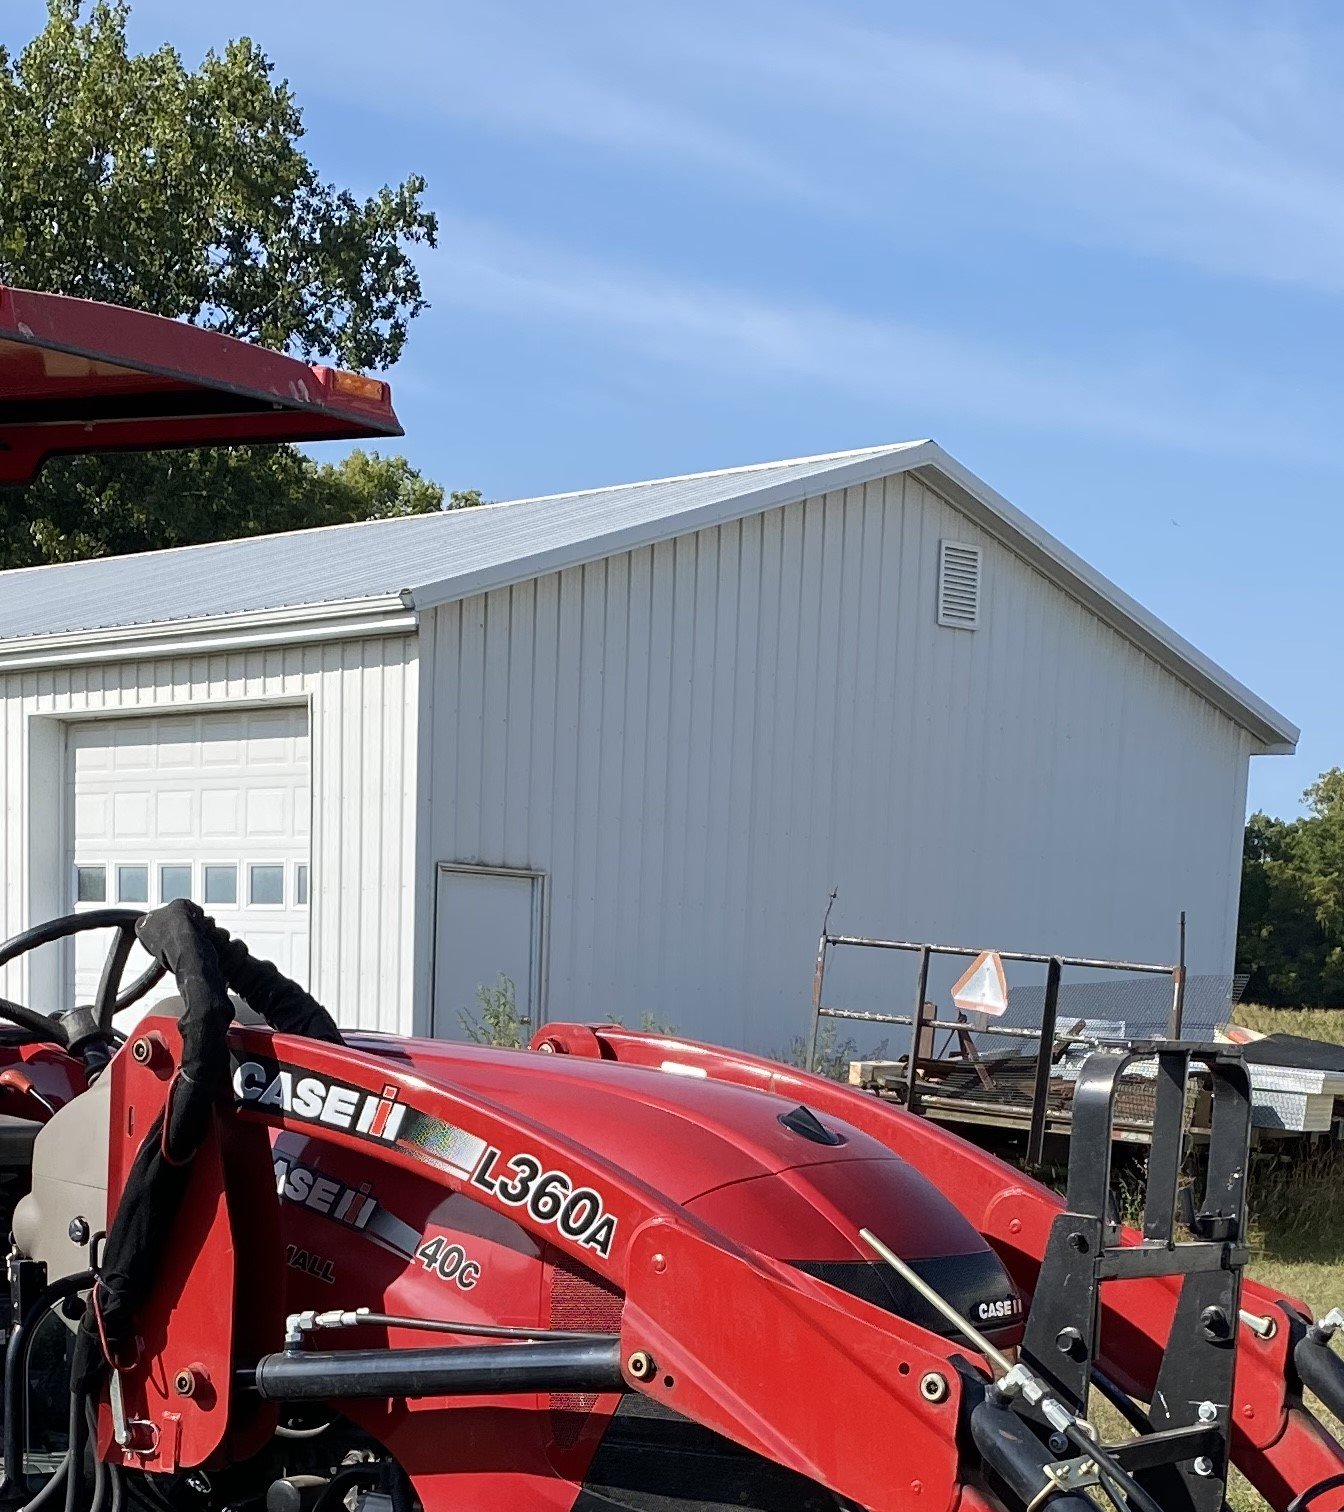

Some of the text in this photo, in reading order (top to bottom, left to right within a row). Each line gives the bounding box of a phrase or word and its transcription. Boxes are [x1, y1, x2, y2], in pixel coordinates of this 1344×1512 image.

[232, 1061, 360, 1128] CASE
[471, 1146, 618, 1260] L360A
[978, 1301, 1011, 1319] CASE
